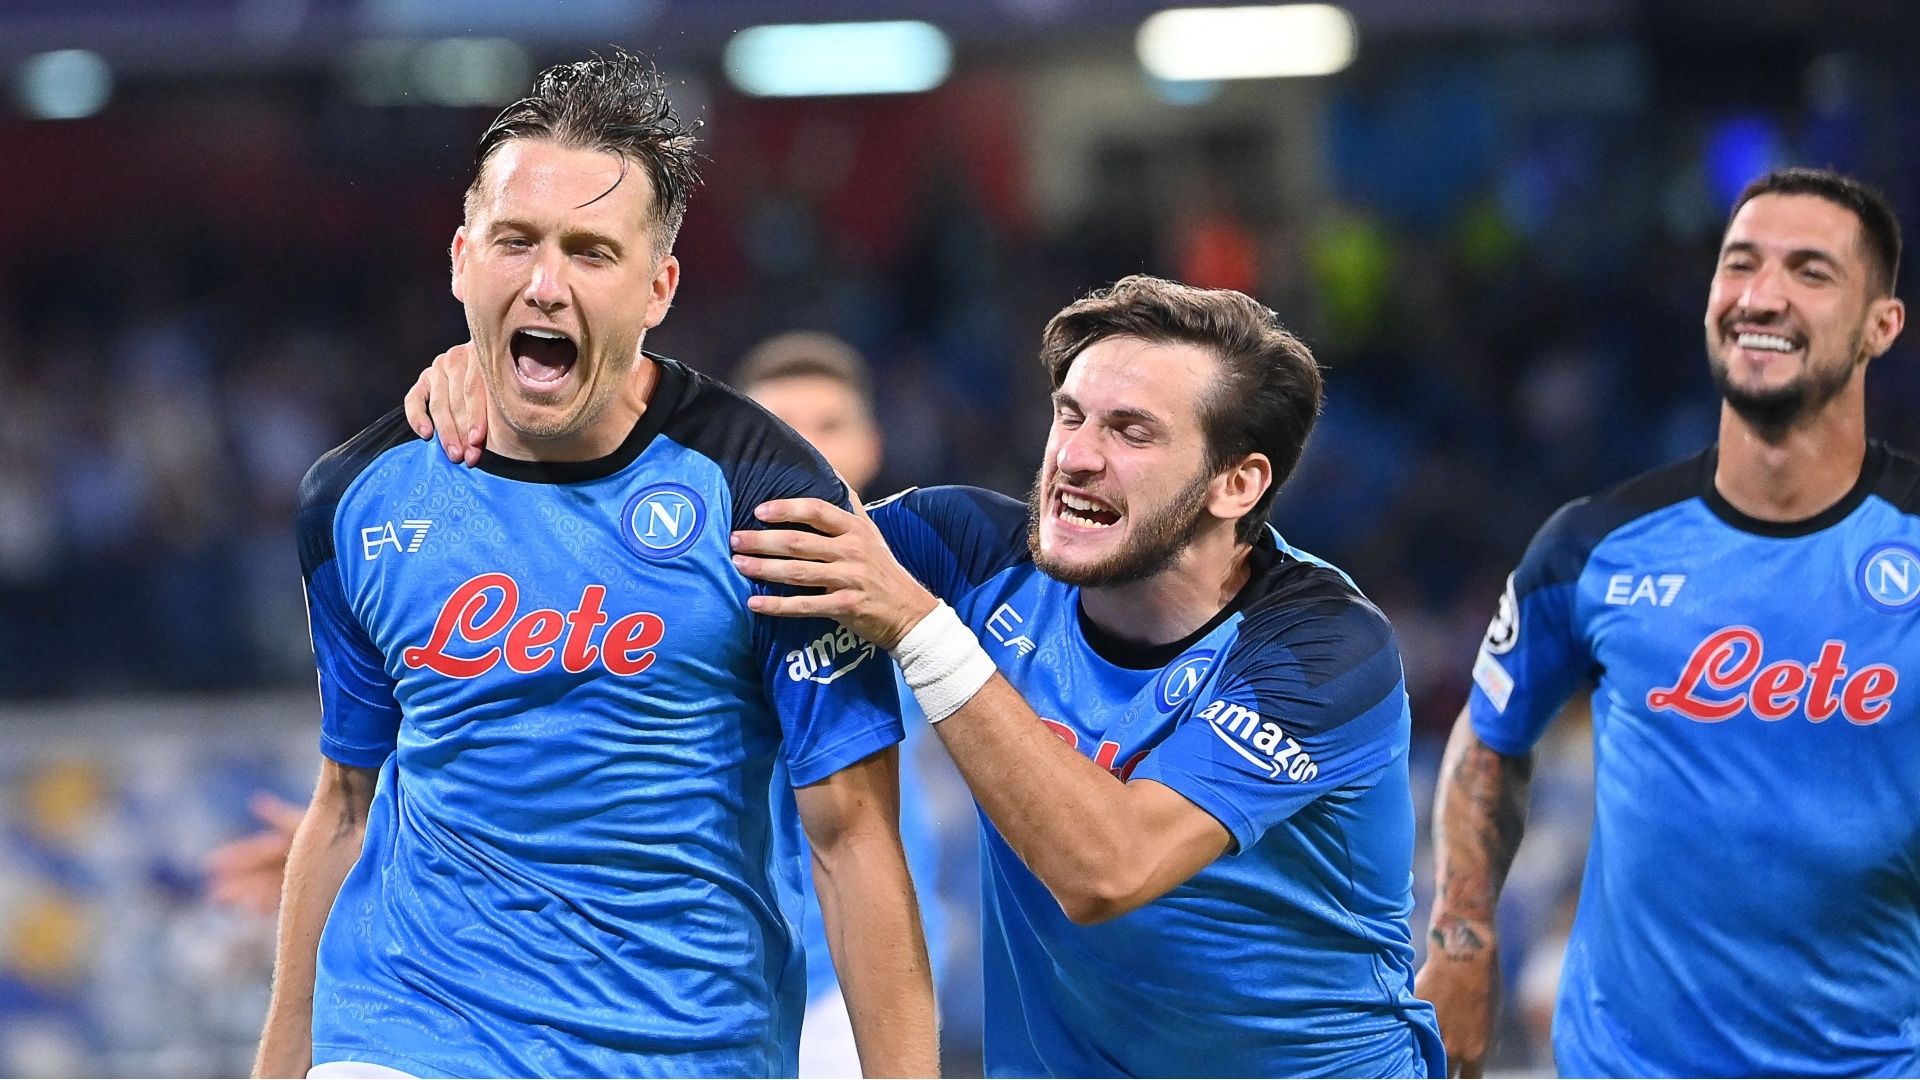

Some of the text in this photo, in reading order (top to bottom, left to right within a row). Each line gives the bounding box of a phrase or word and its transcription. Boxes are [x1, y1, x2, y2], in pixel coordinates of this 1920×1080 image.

[361, 519, 433, 561] EA7
[644, 501, 685, 538] N
[1605, 574, 1687, 607] EA7
[1879, 559, 1910, 596] N
[403, 572, 665, 680] Lete
[786, 624, 866, 682] ama
[1169, 667, 1207, 697] N
[1646, 624, 1898, 726] Lete
[1196, 700, 1318, 783] amazon
